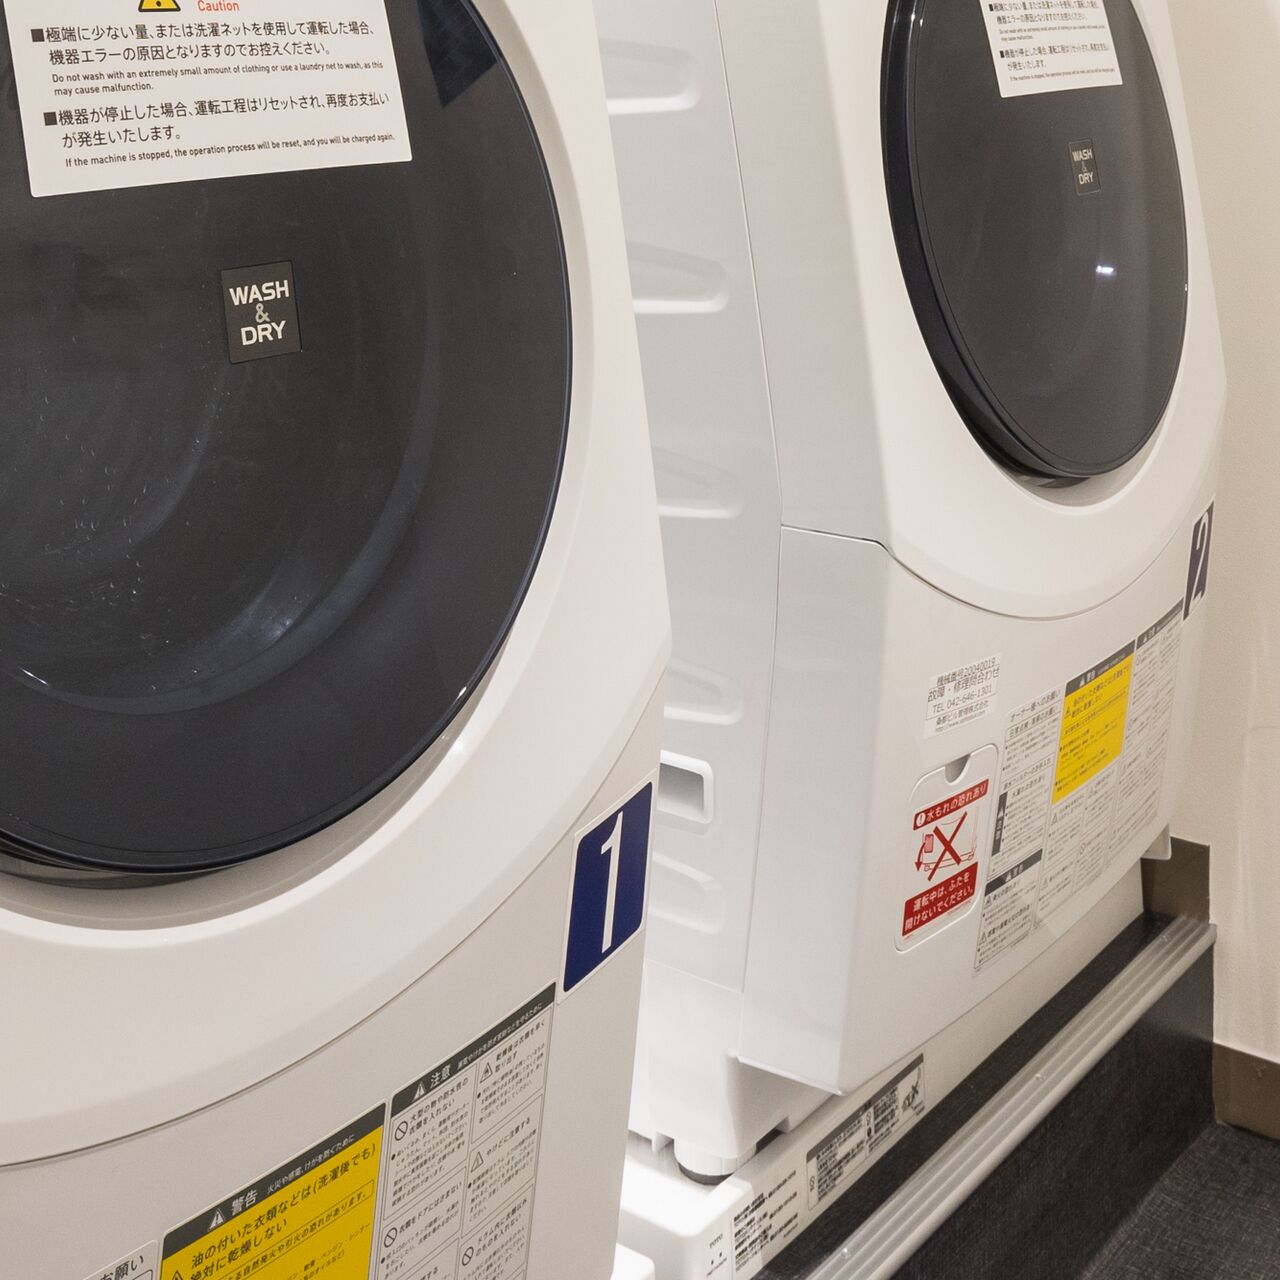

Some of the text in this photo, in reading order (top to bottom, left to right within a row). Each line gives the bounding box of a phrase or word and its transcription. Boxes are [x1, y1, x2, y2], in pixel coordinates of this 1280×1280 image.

[197, 0, 240, 13] Caution
[44, 18, 374, 45] 極端に少ない量、または洗濯ネットを使用して運転した場合、
[48, 38, 329, 67] 機器エラーの原因となりますのでお控えください。
[65, 73, 80, 82] not
[82, 72, 104, 81] wash
[106, 71, 124, 80] with
[138, 68, 178, 81] extremely
[179, 68, 201, 77] small
[203, 66, 231, 76] amount
[242, 65, 270, 76] clothing
[299, 63, 324, 74] laundry
[325, 62, 336, 70] net
[345, 61, 362, 70] wash,
[54, 88, 73, 97] may
[101, 81, 154, 92] malfunction.
[57, 89, 389, 127] 機器が停止した場合、運転工程はリセットされ、再度お支払い
[61, 124, 181, 149] が発生いたします。
[1072, 149, 1093, 162] WASH
[1078, 172, 1094, 185] DRY
[229, 280, 289, 306] WASH
[255, 303, 270, 323] &
[241, 320, 286, 346] DRY
[1194, 511, 1211, 601] 2
[926, 783, 986, 822] 水もれの恐れあり
[600, 810, 623, 955] 1
[430, 1065, 452, 1089] 注意
[231, 1186, 257, 1217] 警告
